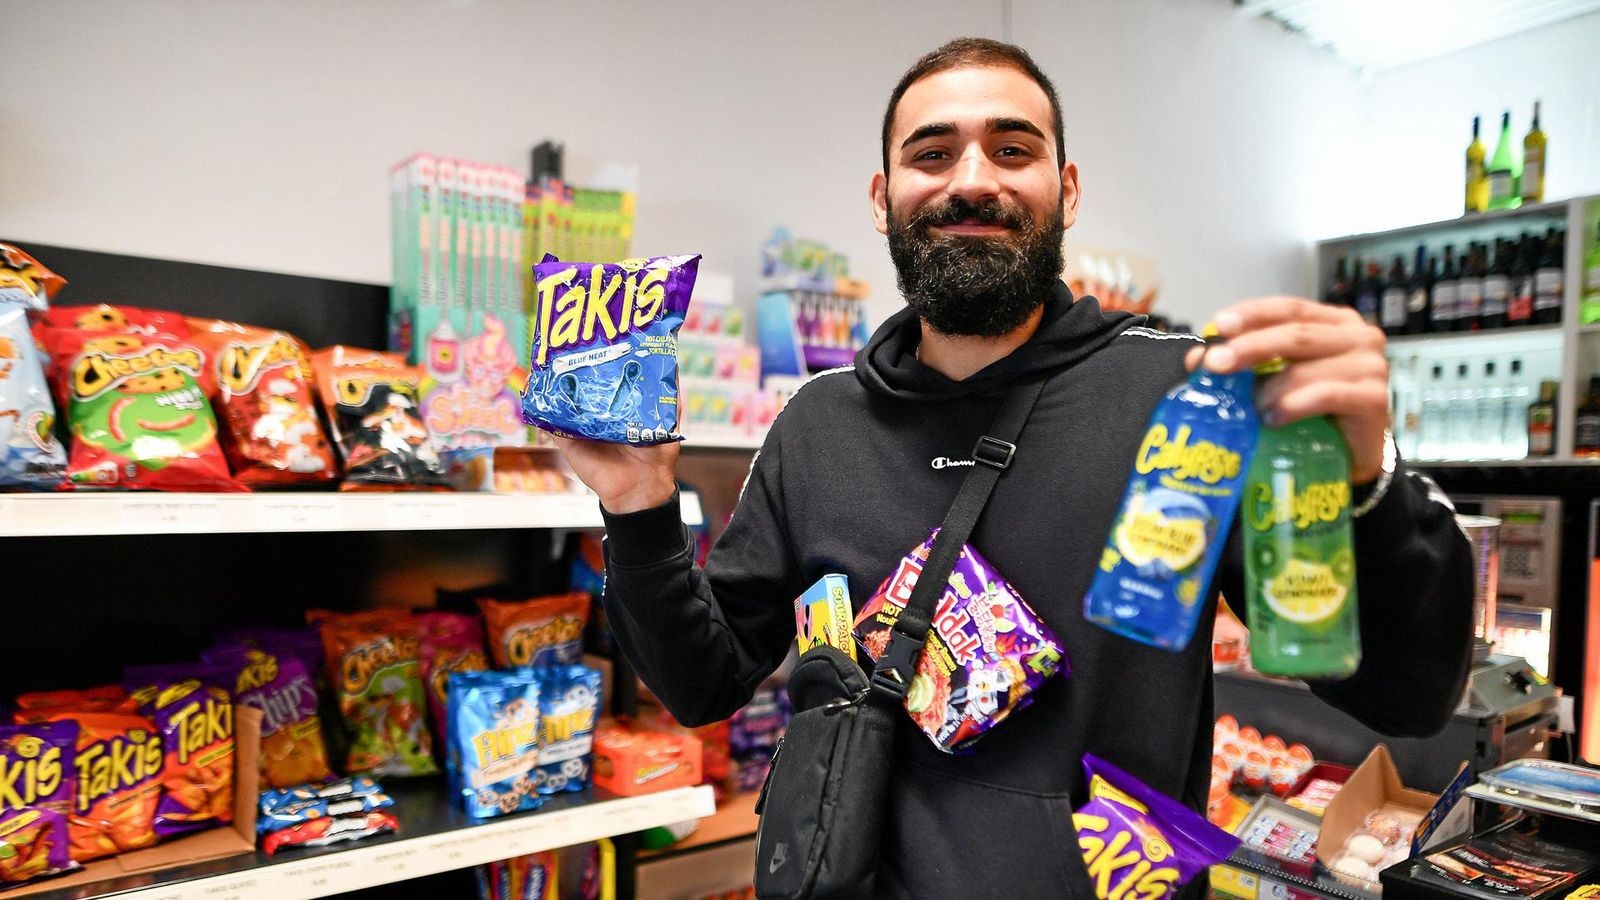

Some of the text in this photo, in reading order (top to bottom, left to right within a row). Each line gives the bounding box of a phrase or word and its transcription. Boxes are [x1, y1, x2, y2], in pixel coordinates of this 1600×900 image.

[537, 264, 669, 365] Takis
[588, 351, 607, 360] HEAT
[1136, 424, 1241, 484] Calypso
[837, 621, 850, 654] PATC
[881, 602, 903, 618] HOT
[169, 699, 232, 764] Taki
[0, 747, 62, 812] kis
[74, 735, 163, 811] Takis
[1072, 813, 1180, 900] kis
